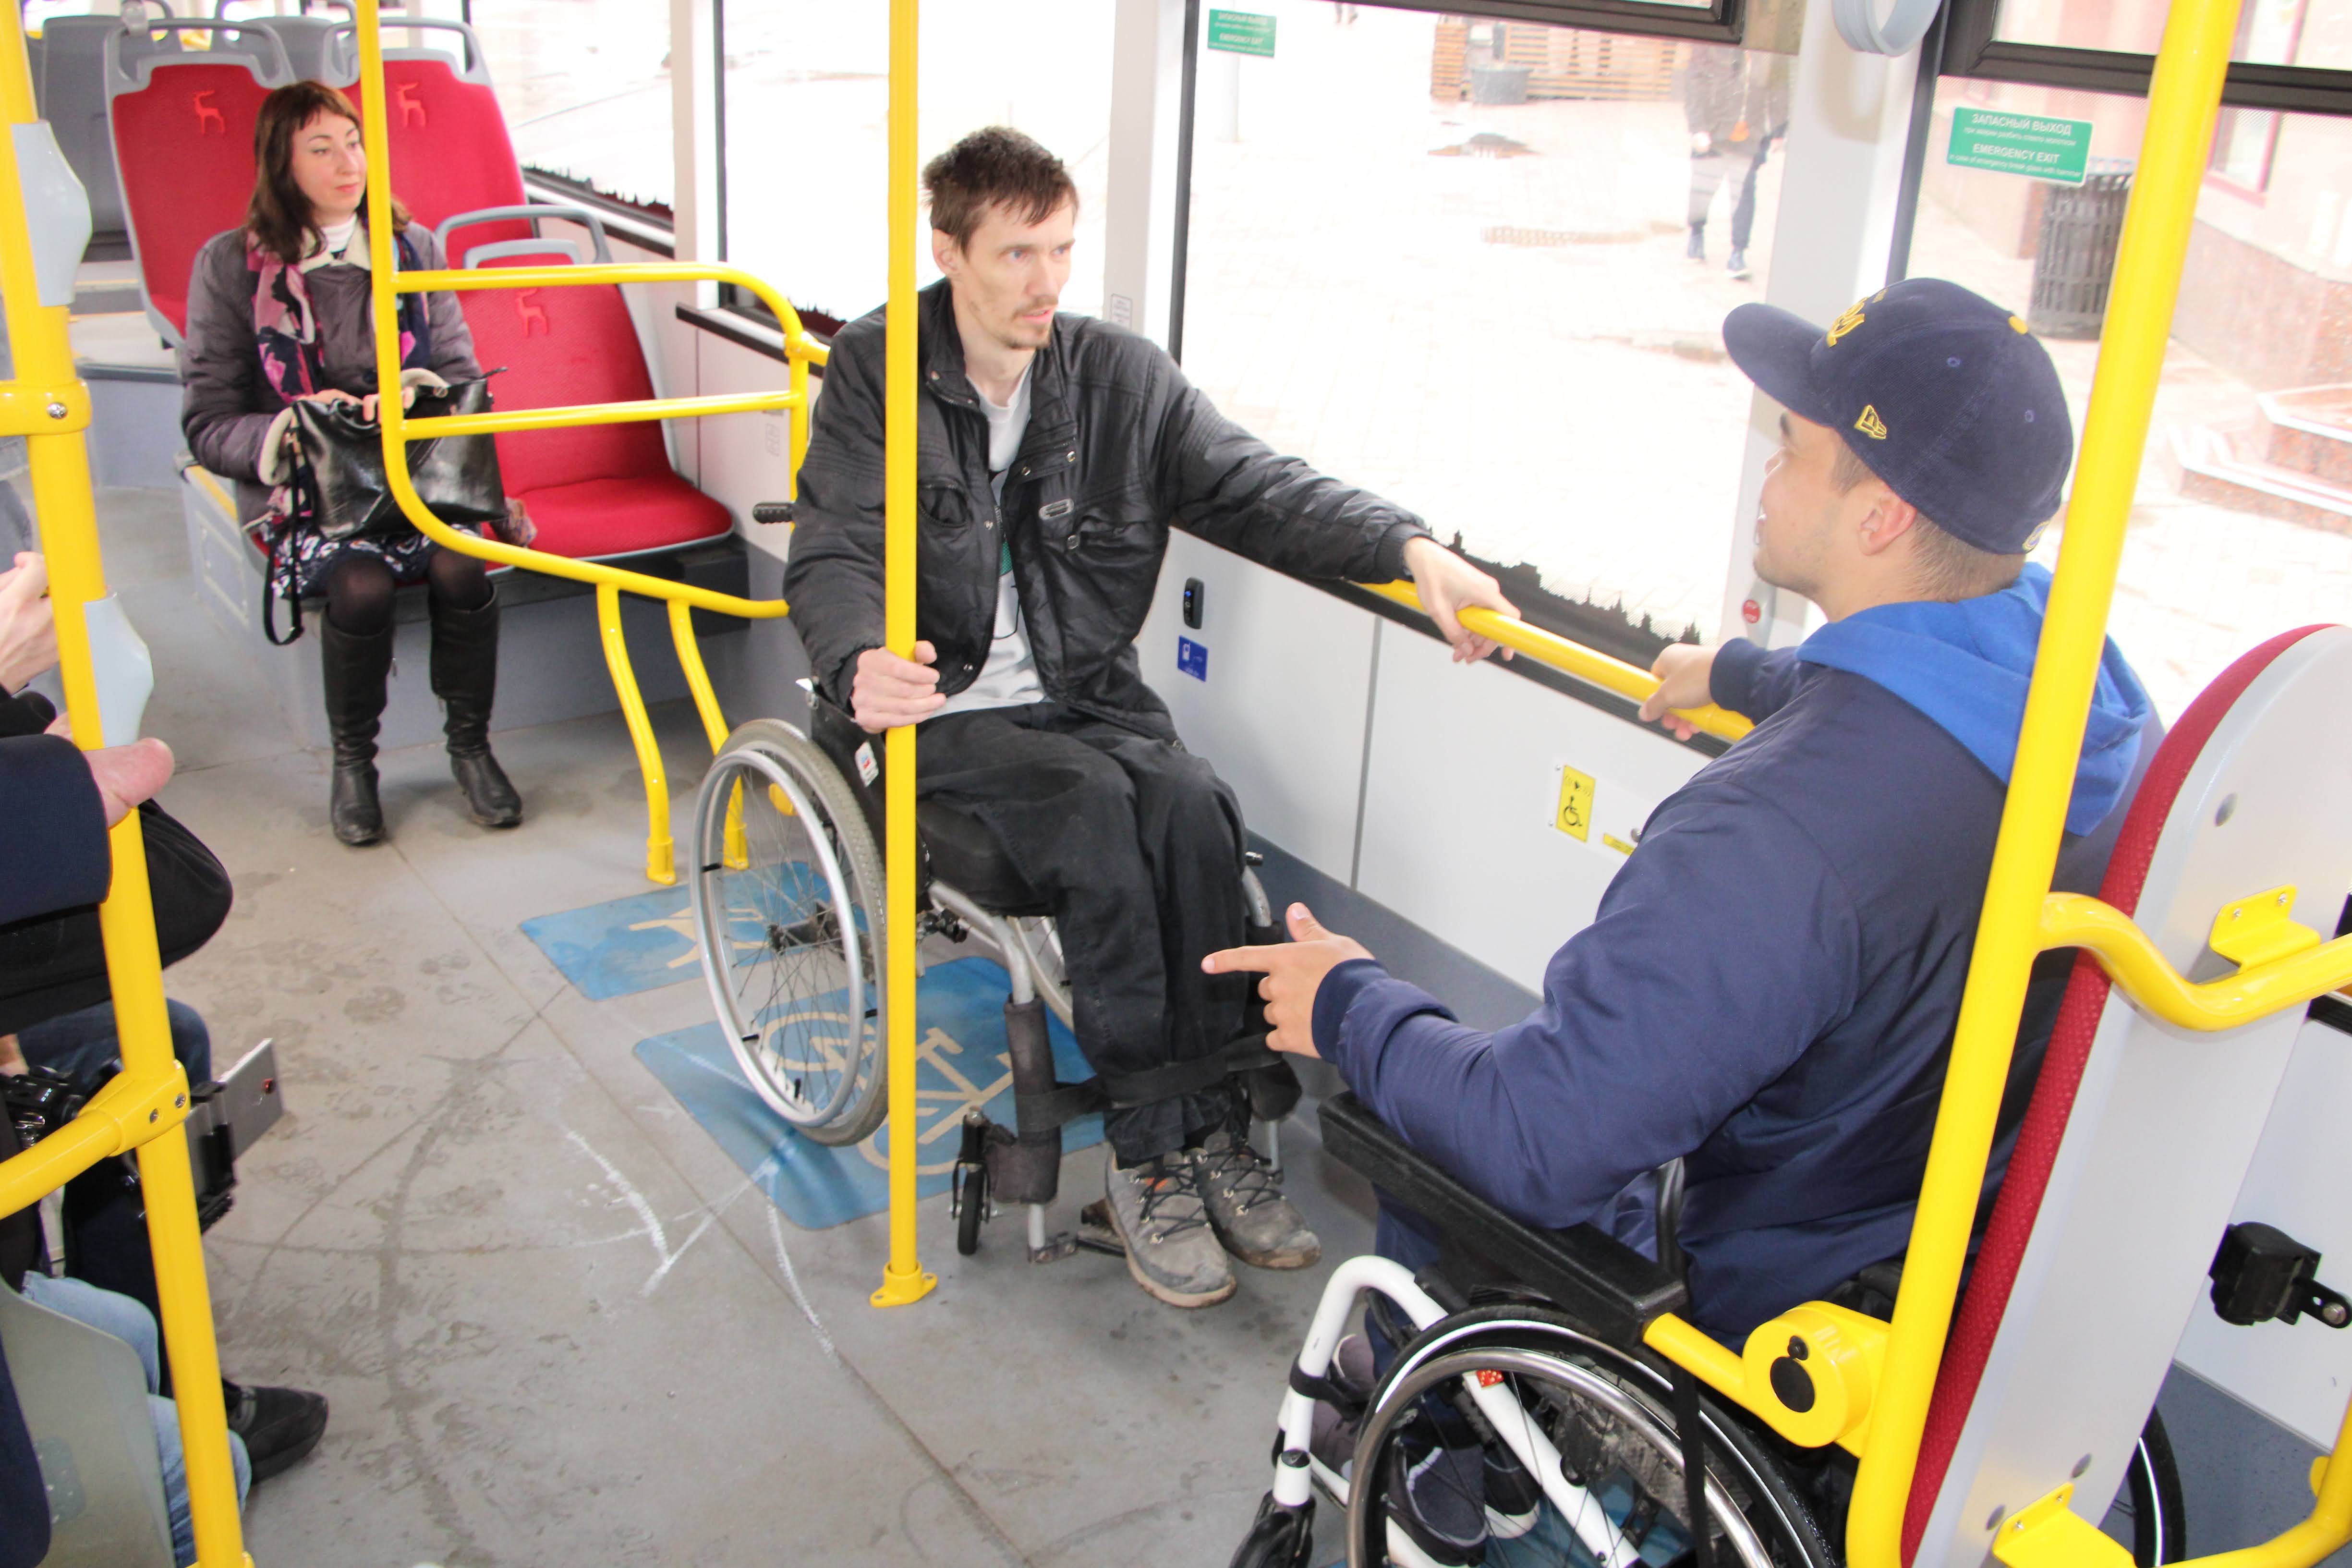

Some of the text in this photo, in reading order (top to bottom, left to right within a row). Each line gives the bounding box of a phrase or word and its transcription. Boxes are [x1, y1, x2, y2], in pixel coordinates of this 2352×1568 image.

[1971, 113, 2072, 136] ЗАПАСНЫЙ ВЫХОД
[1973, 143, 2036, 160] EMERGENCY
[2036, 152, 2061, 163] EXIT
